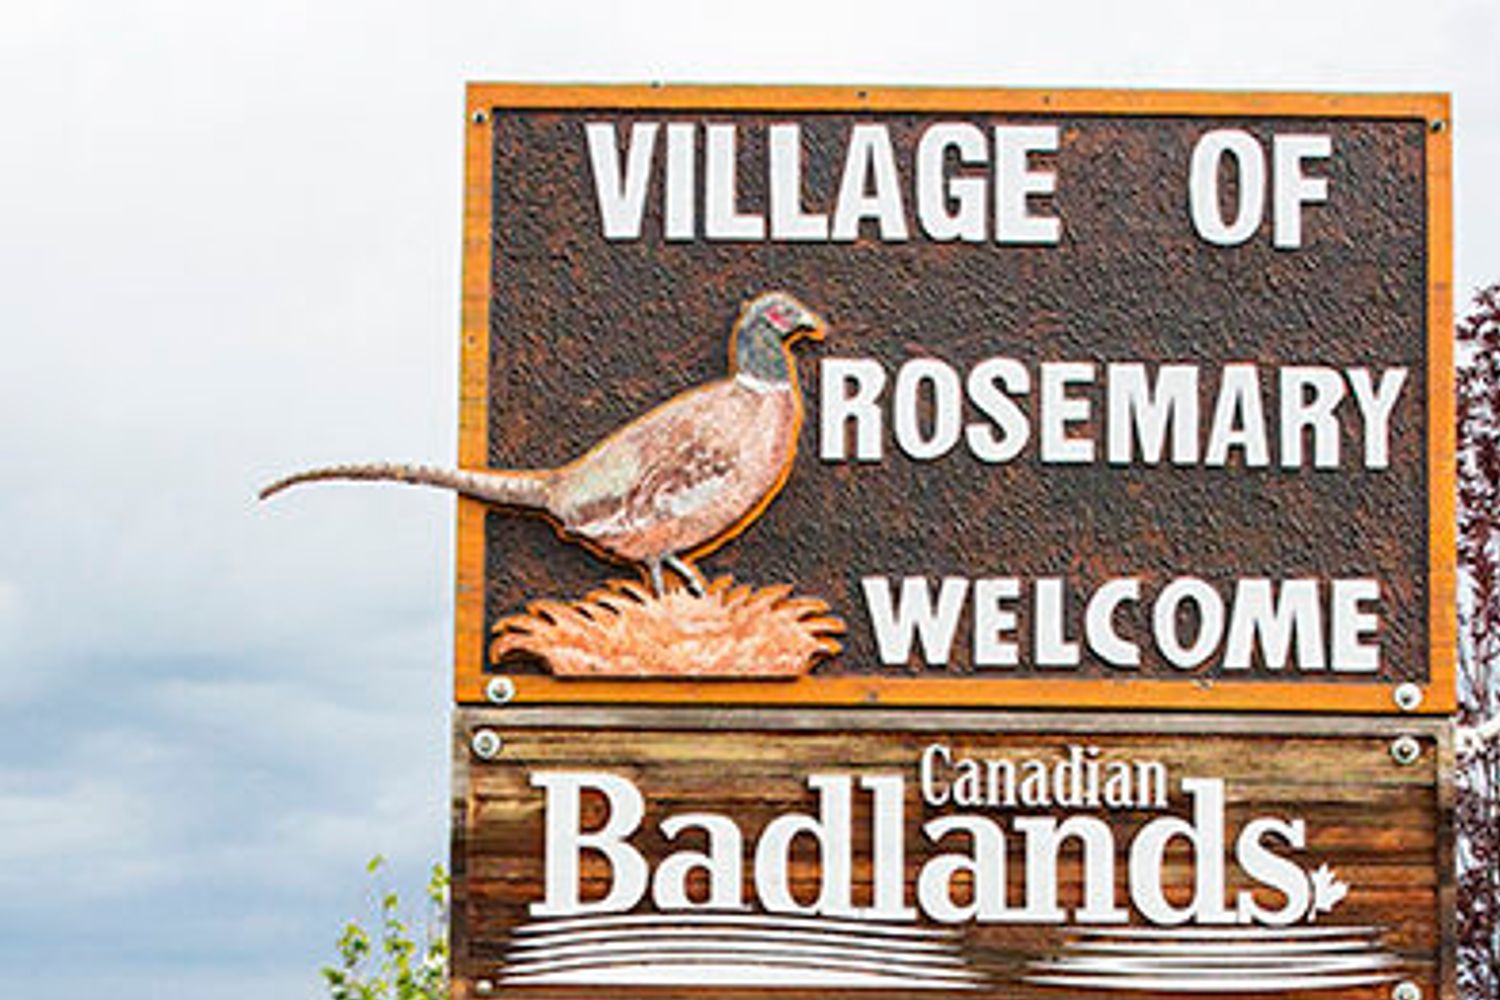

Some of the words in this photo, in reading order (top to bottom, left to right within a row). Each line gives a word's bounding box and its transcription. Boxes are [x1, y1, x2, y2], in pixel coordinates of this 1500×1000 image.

[586, 120, 1061, 244] VILLAGE
[1188, 128, 1333, 249] OF
[818, 356, 1409, 469] ROSEMARY
[861, 576, 1381, 673] WELCOME
[920, 743, 1168, 810] Canadian
[529, 768, 1314, 926] Badlands
